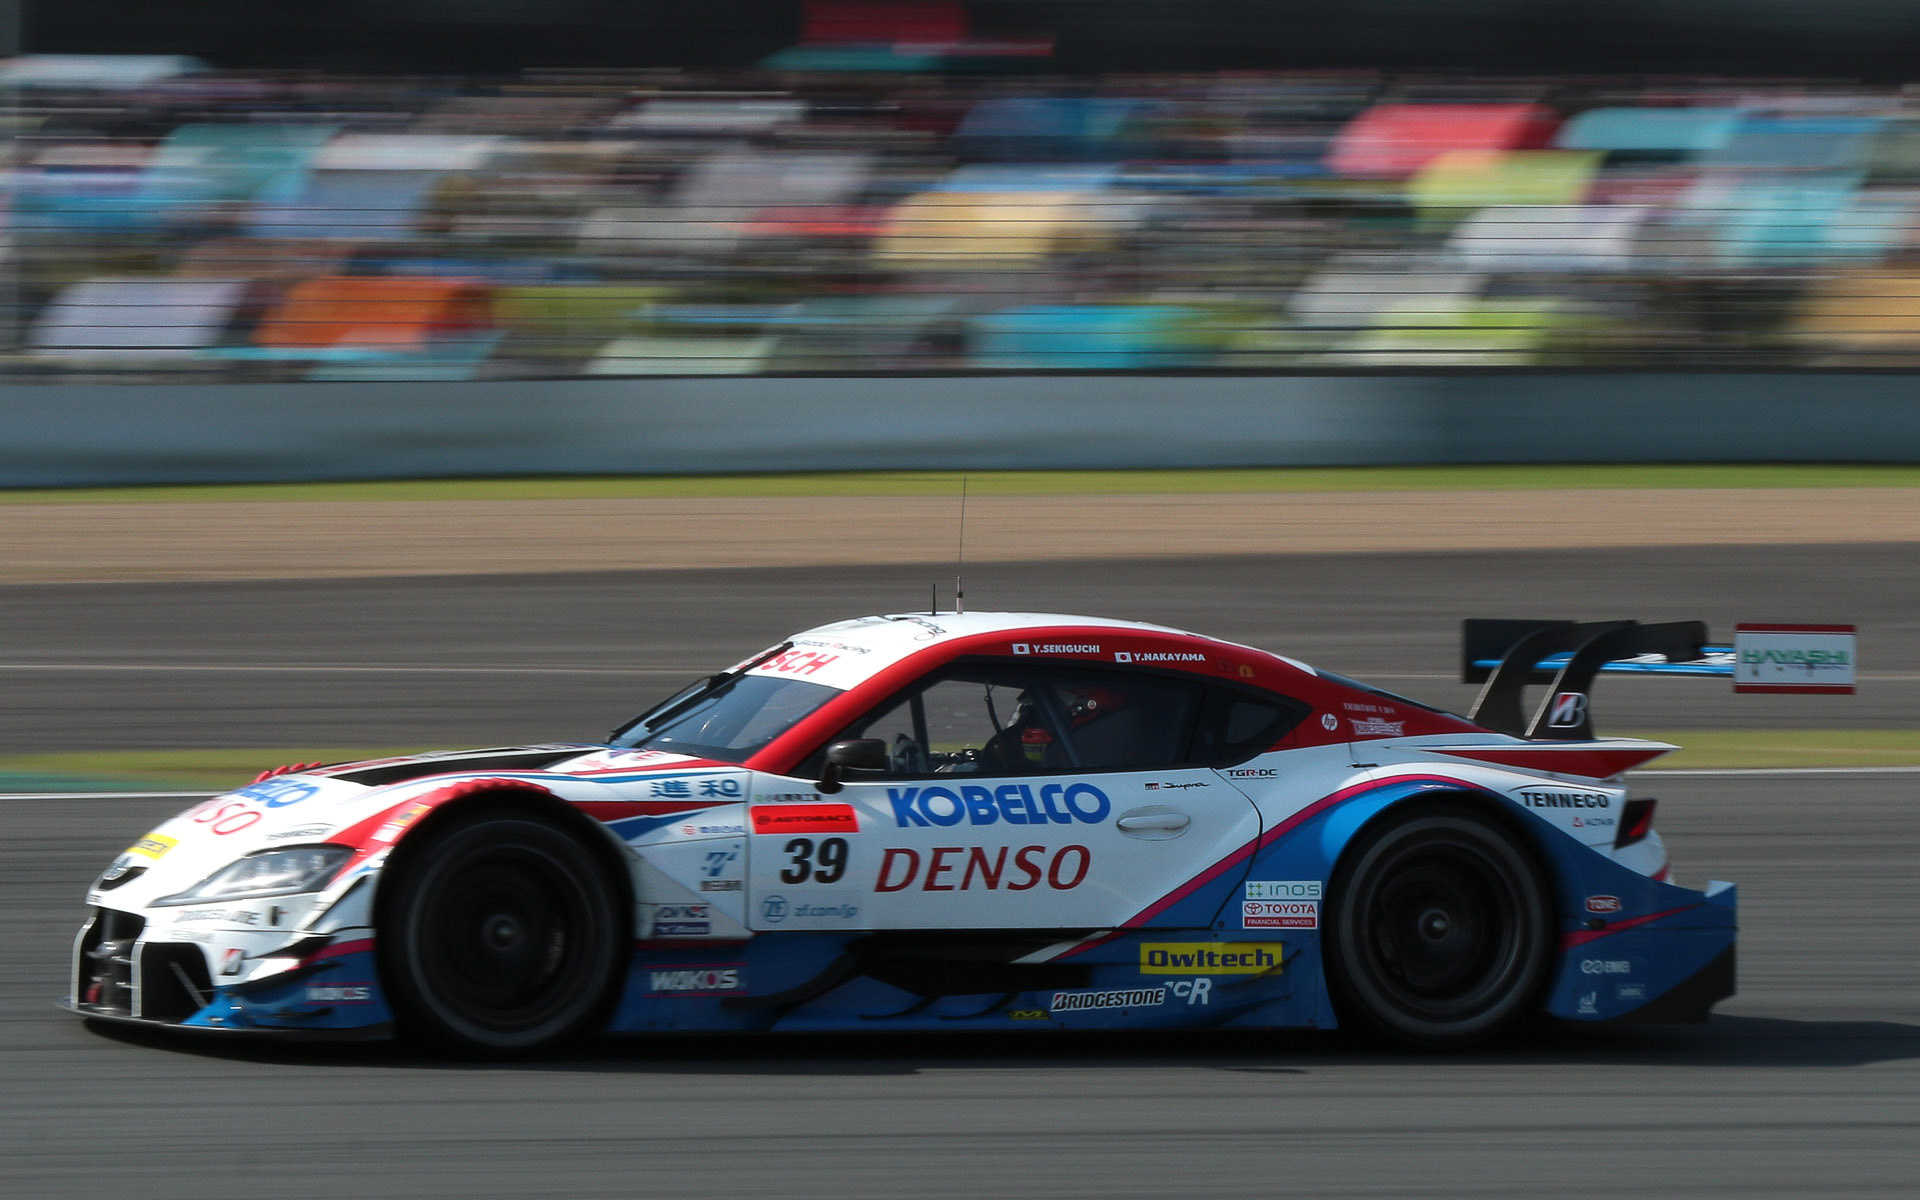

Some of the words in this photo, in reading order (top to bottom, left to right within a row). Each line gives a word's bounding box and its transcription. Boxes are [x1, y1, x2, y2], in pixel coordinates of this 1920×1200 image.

[1033, 643, 1100, 654] Y.SEKIGUCHI
[1134, 652, 1206, 662] Y.NAKAYAMA
[651, 779, 743, 798] 進和
[1161, 781, 1212, 792] Supra
[886, 782, 1111, 828] KOBELCO
[1520, 791, 1610, 809] TENNECO
[774, 814, 853, 823] AUTOBACS
[779, 837, 849, 885] 39
[873, 844, 1092, 893] DENSO
[794, 903, 858, 919] zf.com/jp
[1264, 904, 1316, 914] TOYOTA
[1247, 918, 1281, 926] FINANCIAL
[1282, 918, 1313, 926] SERVICES
[1149, 948, 1275, 968] Owltech
[1051, 987, 1166, 1012] BRIDGESTONE
